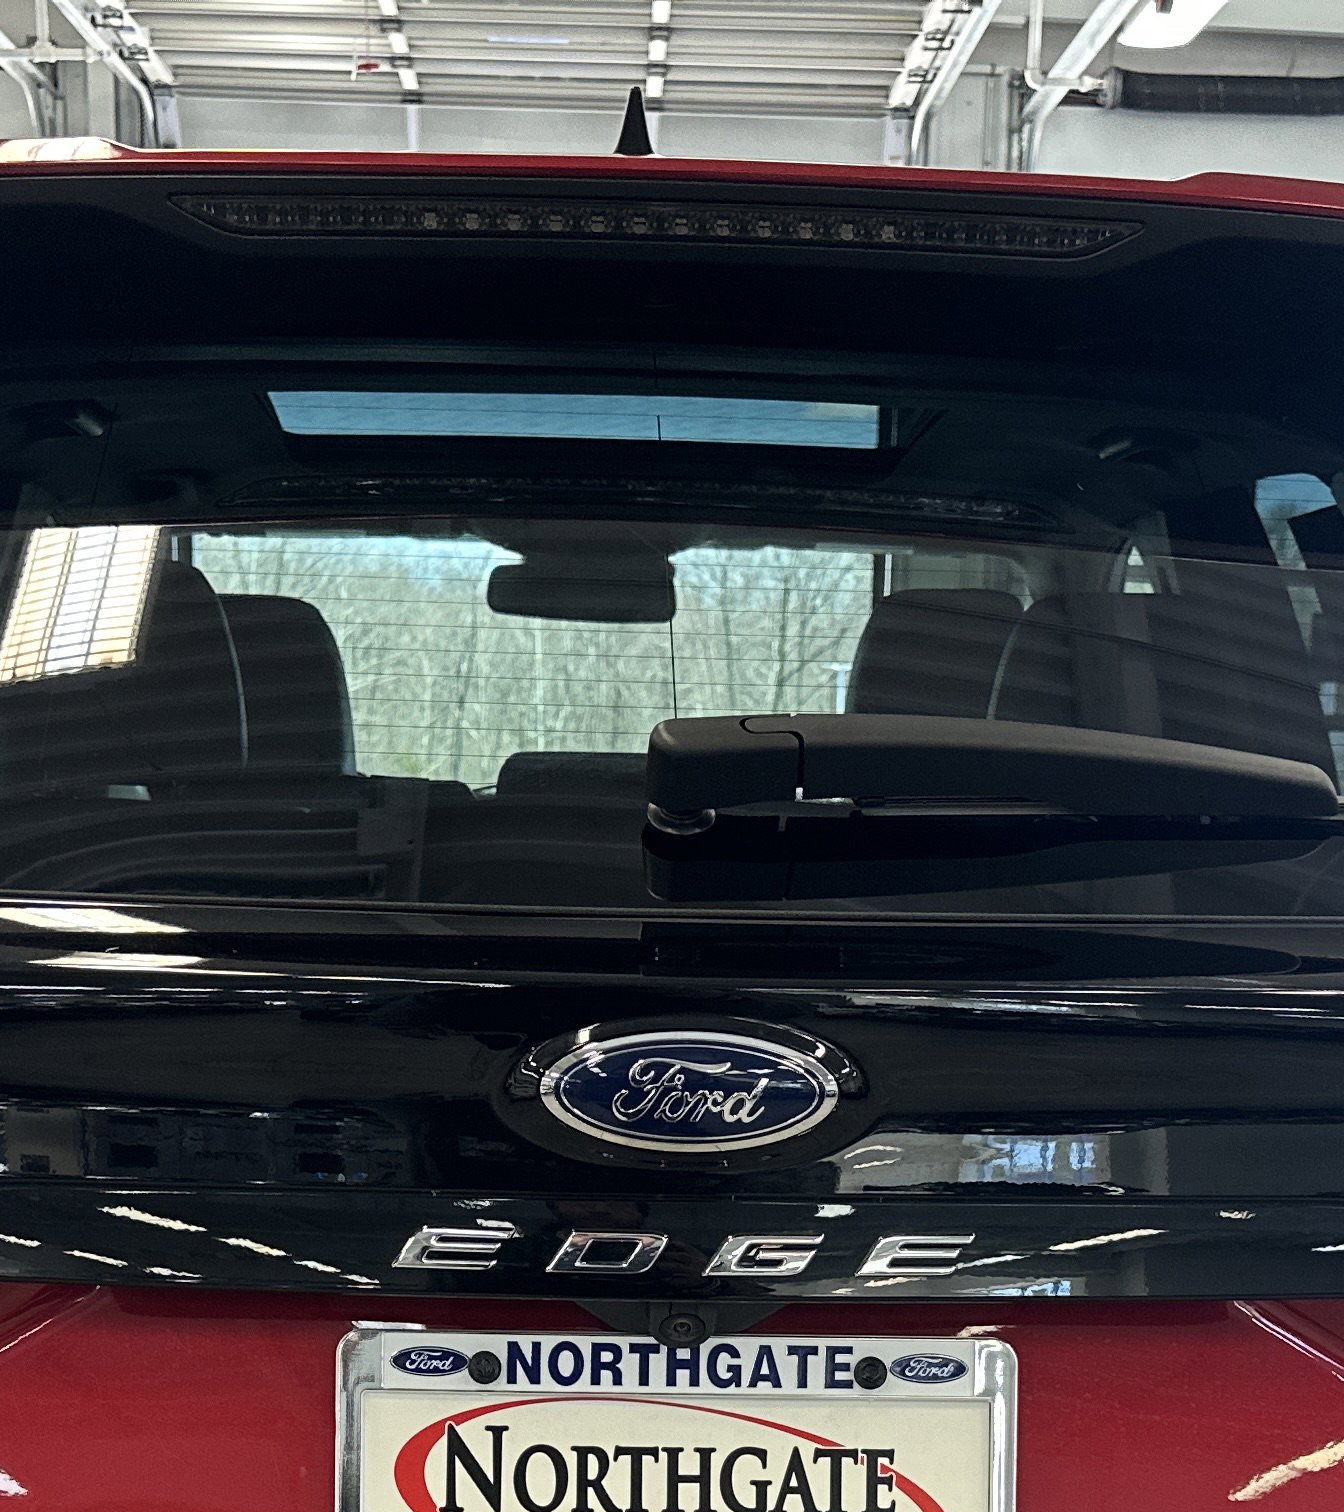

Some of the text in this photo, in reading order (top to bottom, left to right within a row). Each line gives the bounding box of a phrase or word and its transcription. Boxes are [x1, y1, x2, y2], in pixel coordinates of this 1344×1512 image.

[612, 1056, 770, 1124] Ford
[392, 1224, 976, 1276] EDGE
[405, 1341, 955, 1389] Ford NORTHGATE Ford
